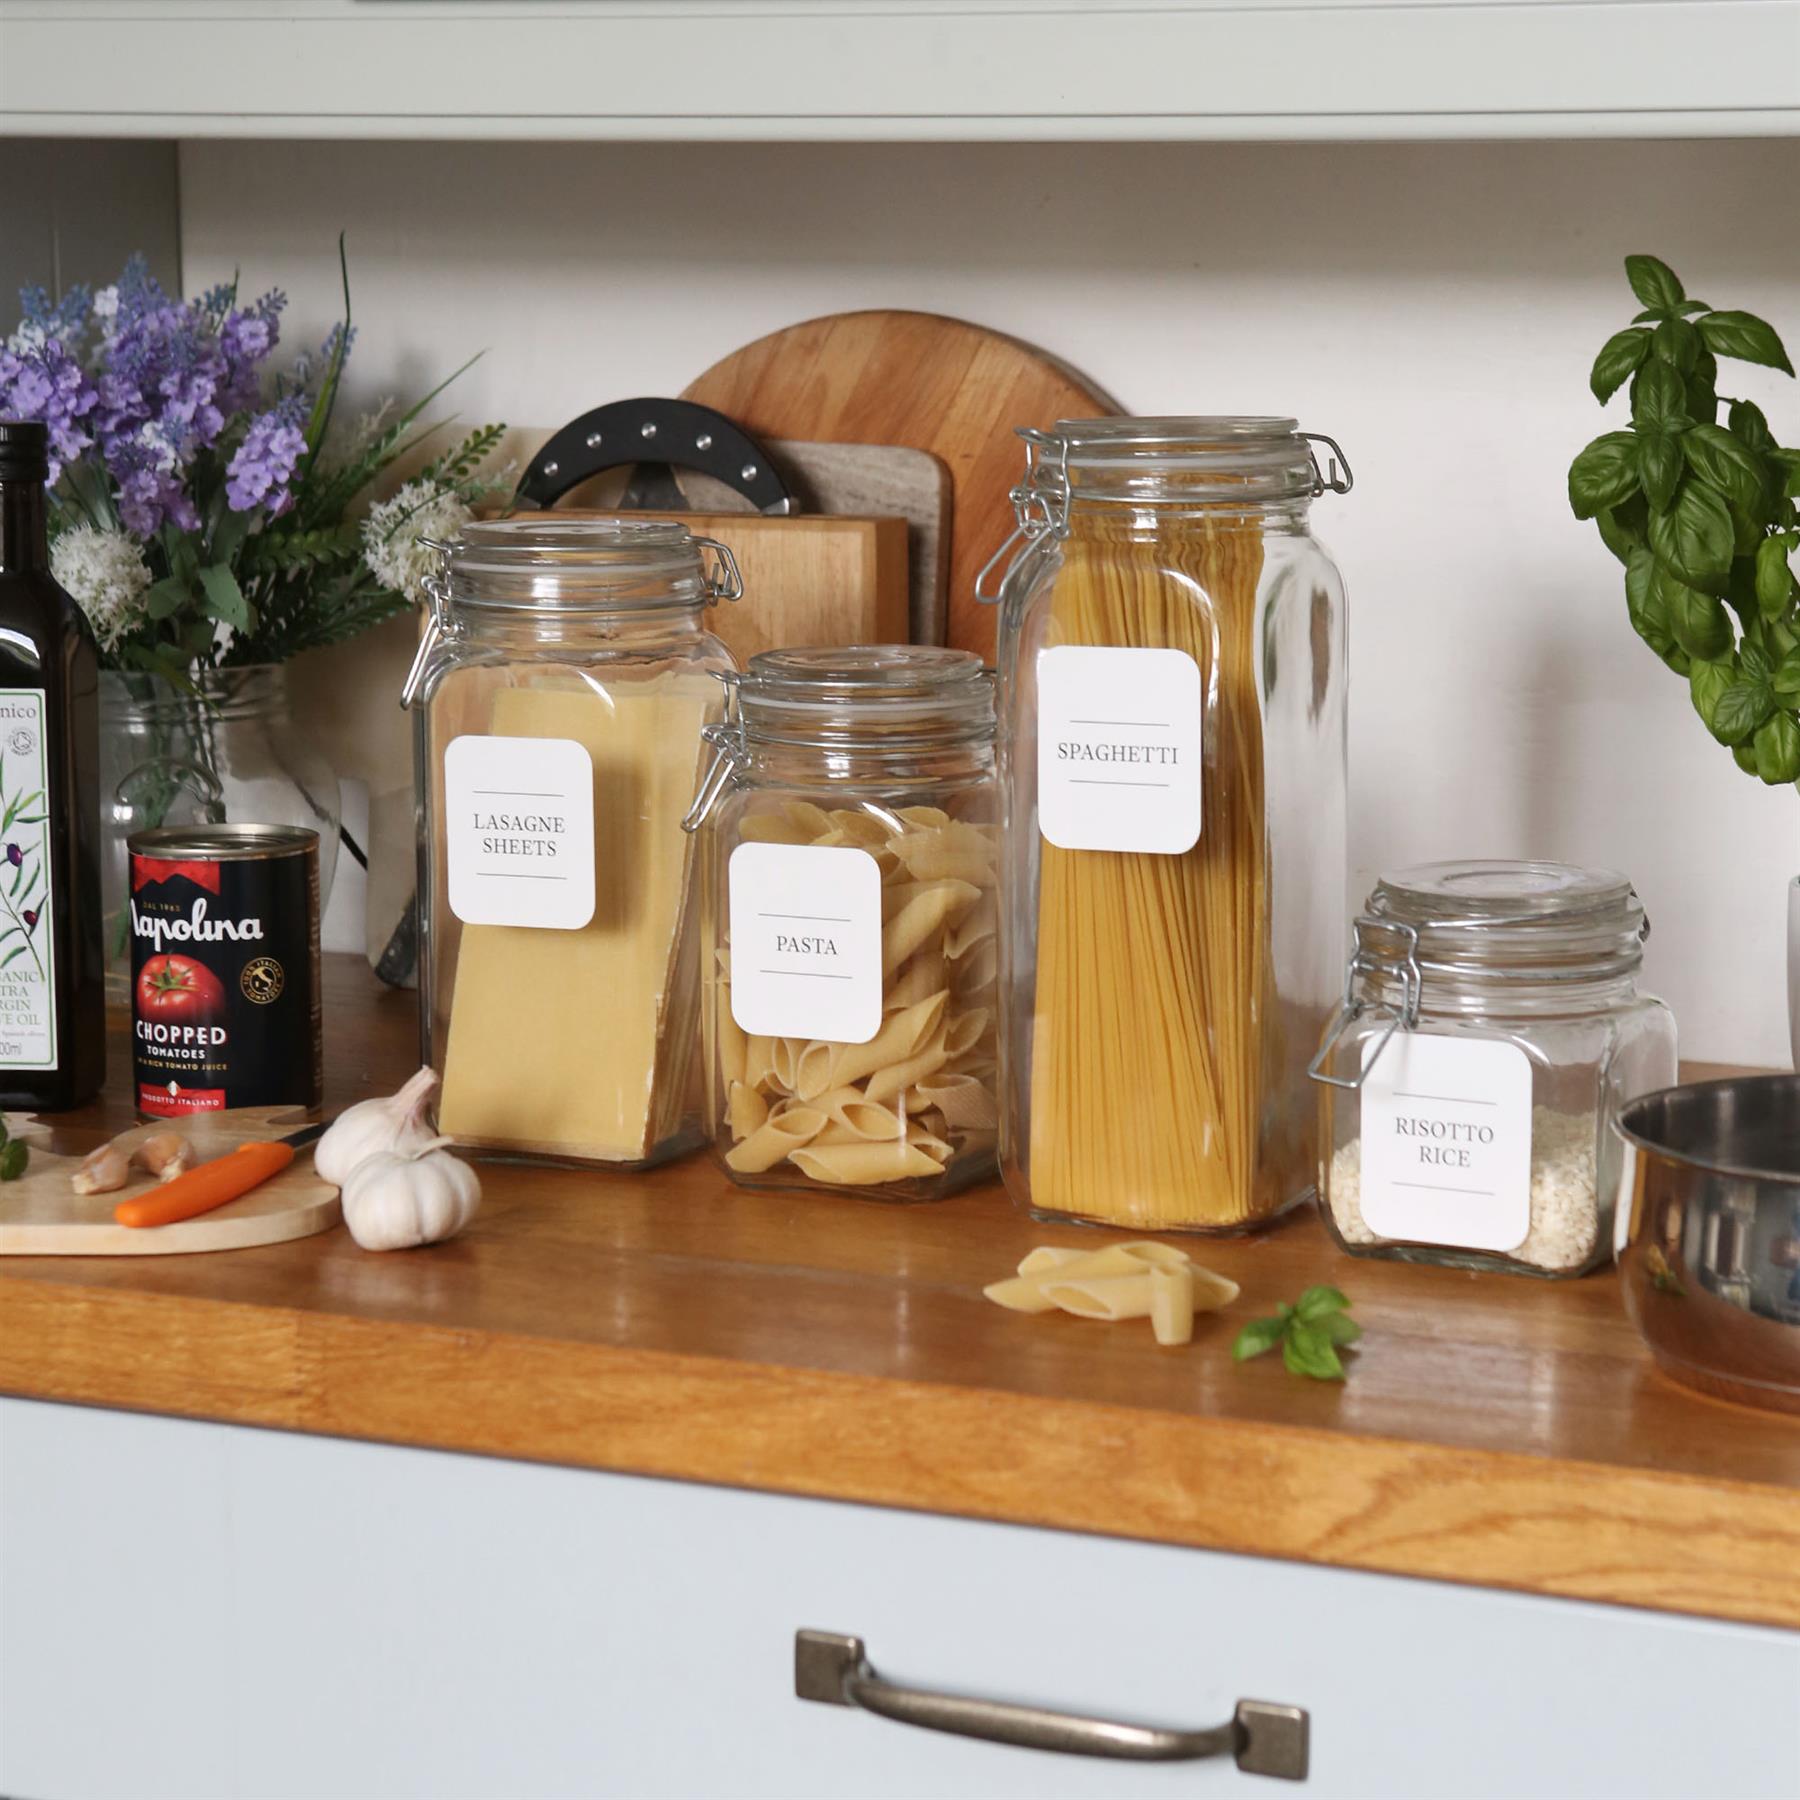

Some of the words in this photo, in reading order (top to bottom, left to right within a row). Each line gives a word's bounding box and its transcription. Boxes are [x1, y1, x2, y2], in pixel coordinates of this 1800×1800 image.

[1057, 742, 1179, 765] SPAGHETTI
[473, 813, 566, 834] LASAGNE
[482, 838, 558, 857] SHEETS
[776, 935, 839, 956] PASTA
[16, 1014, 41, 1026] OIL
[136, 1019, 227, 1045] CHOPPED
[146, 1044, 206, 1059] TOMATOES
[1395, 1116, 1495, 1145] RISOTTO
[1419, 1145, 1472, 1168] RICE
